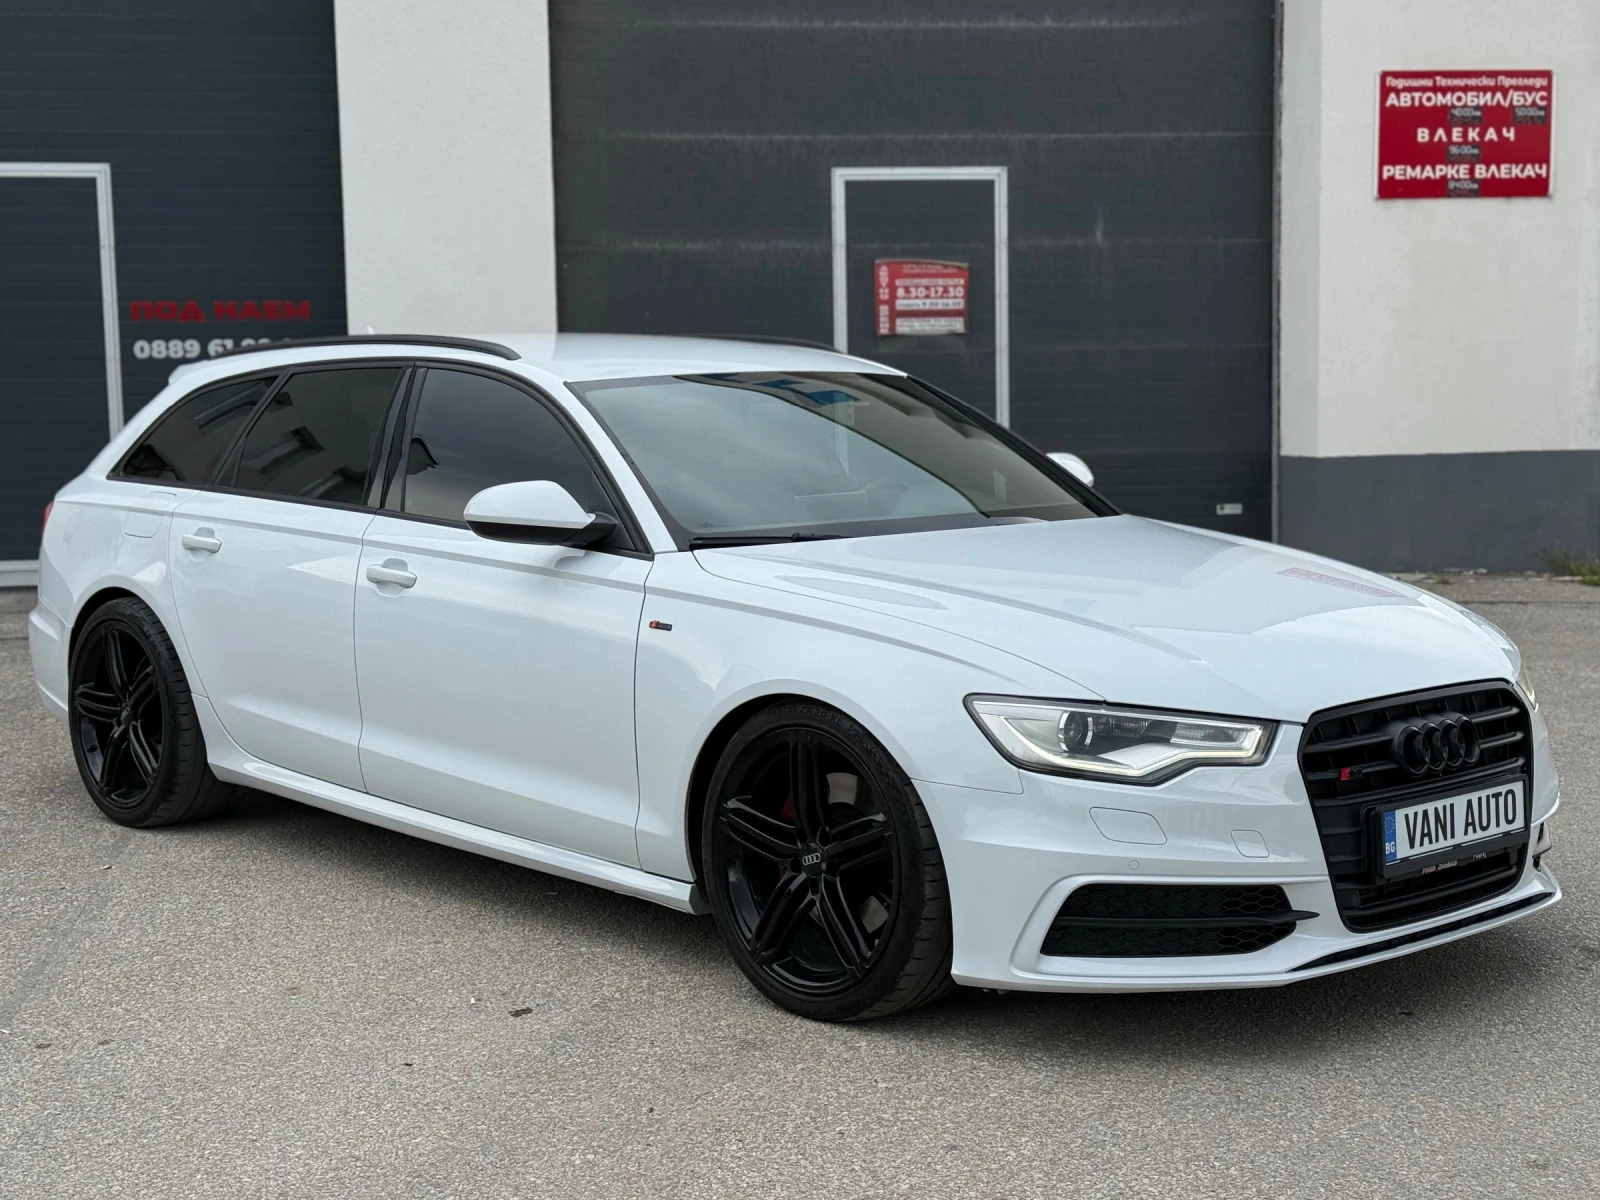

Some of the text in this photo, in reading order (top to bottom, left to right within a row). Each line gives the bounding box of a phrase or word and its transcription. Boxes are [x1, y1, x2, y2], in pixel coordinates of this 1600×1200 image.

[1386, 75, 1548, 89] Годишни Технически Прегледи
[1386, 89, 1548, 107] АВТОМОБИЛ/БУС
[1382, 163, 1547, 180] РЕМАРКЕ ВЛЕКАЧ
[130, 299, 311, 324] ПОД НАЕМ
[133, 338, 201, 360] 0889
[1404, 788, 1517, 849] VANI AUTO
[1385, 841, 1396, 854] BG
